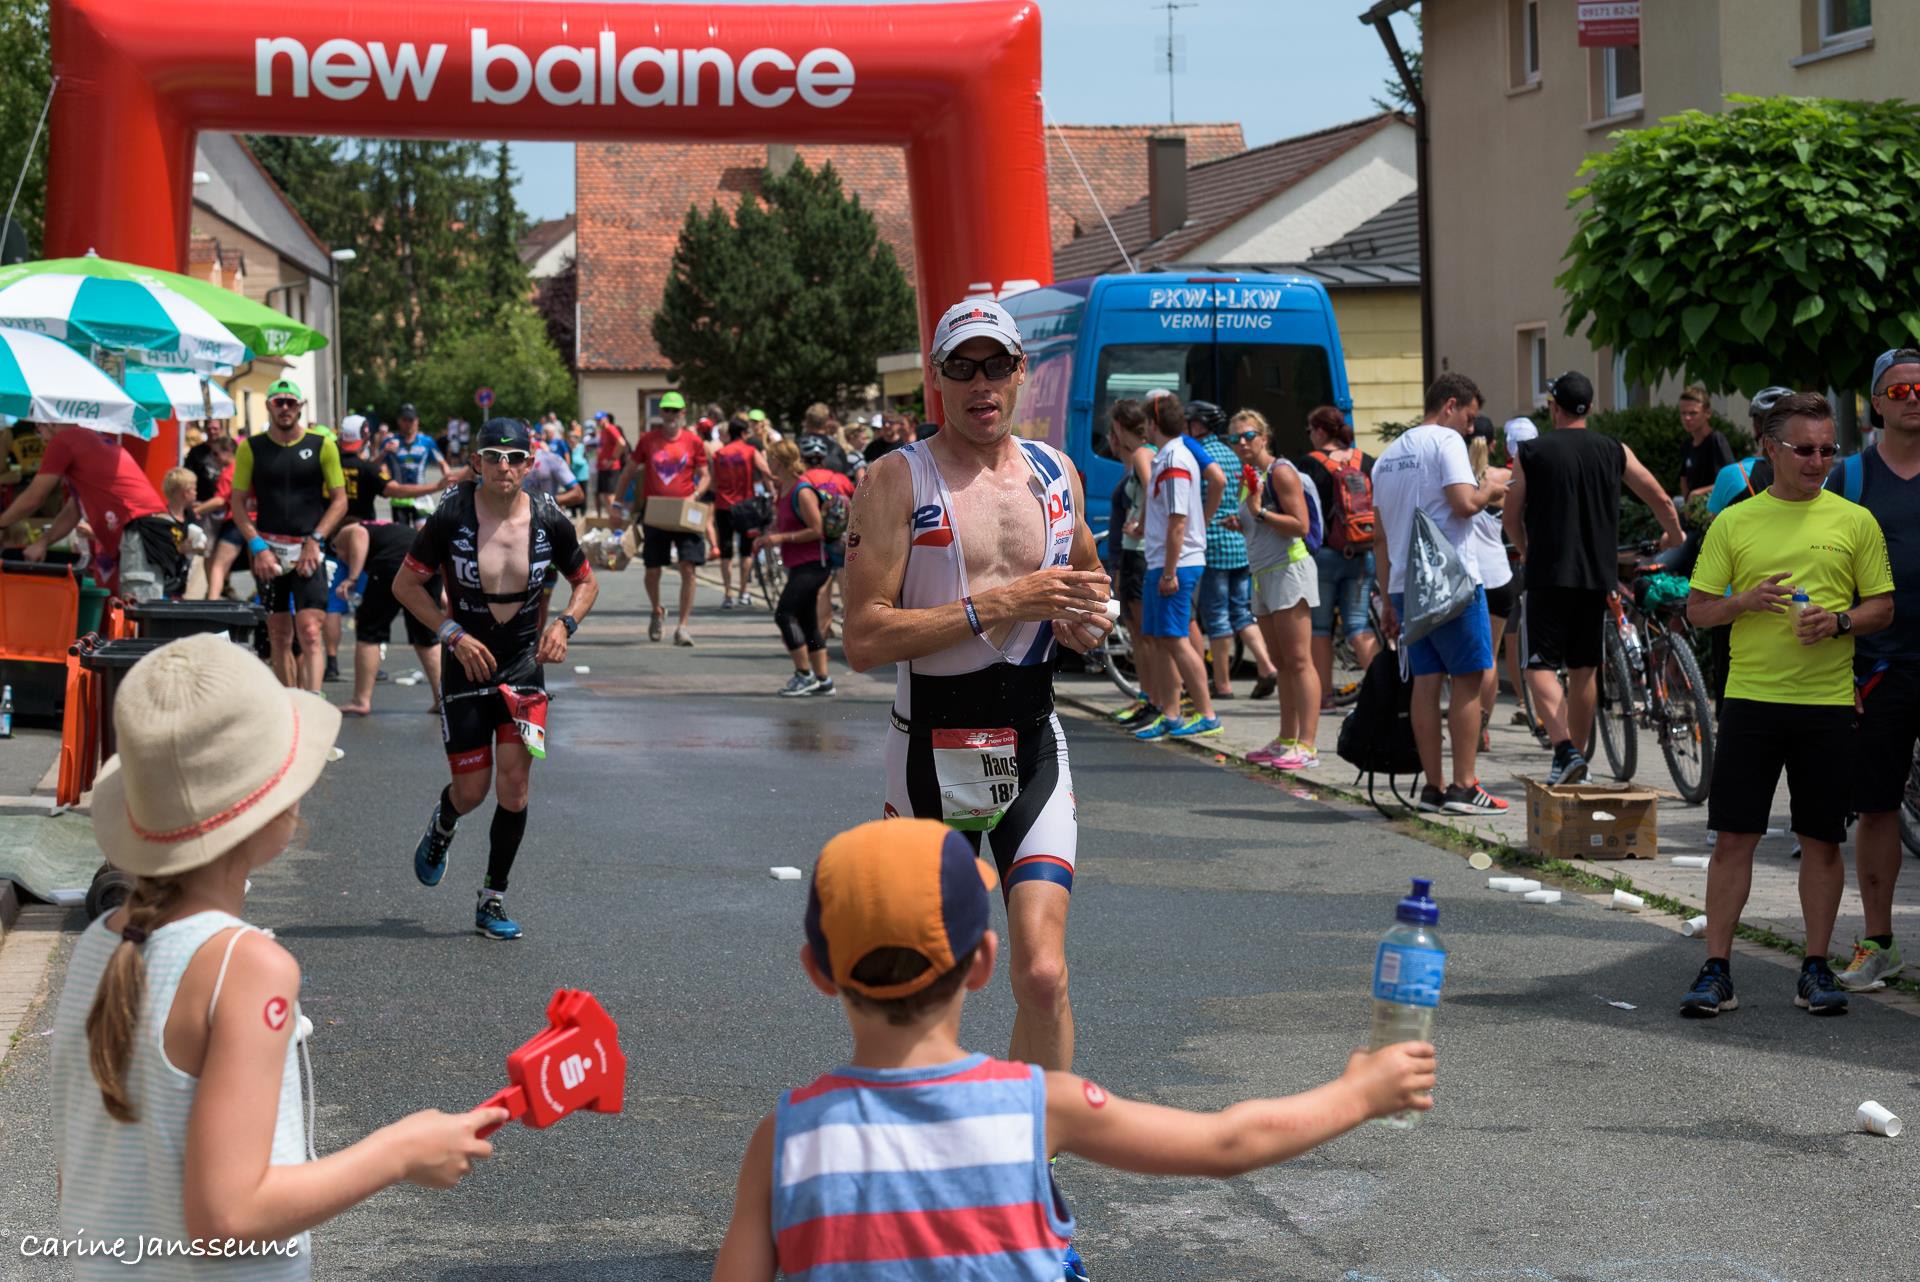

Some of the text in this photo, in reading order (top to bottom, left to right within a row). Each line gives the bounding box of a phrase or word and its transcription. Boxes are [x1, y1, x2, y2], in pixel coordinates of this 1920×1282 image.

[255, 28, 856, 109] new balance
[1160, 314, 1272, 329] VERMIETUNG
[980, 753, 1018, 777] Hans
